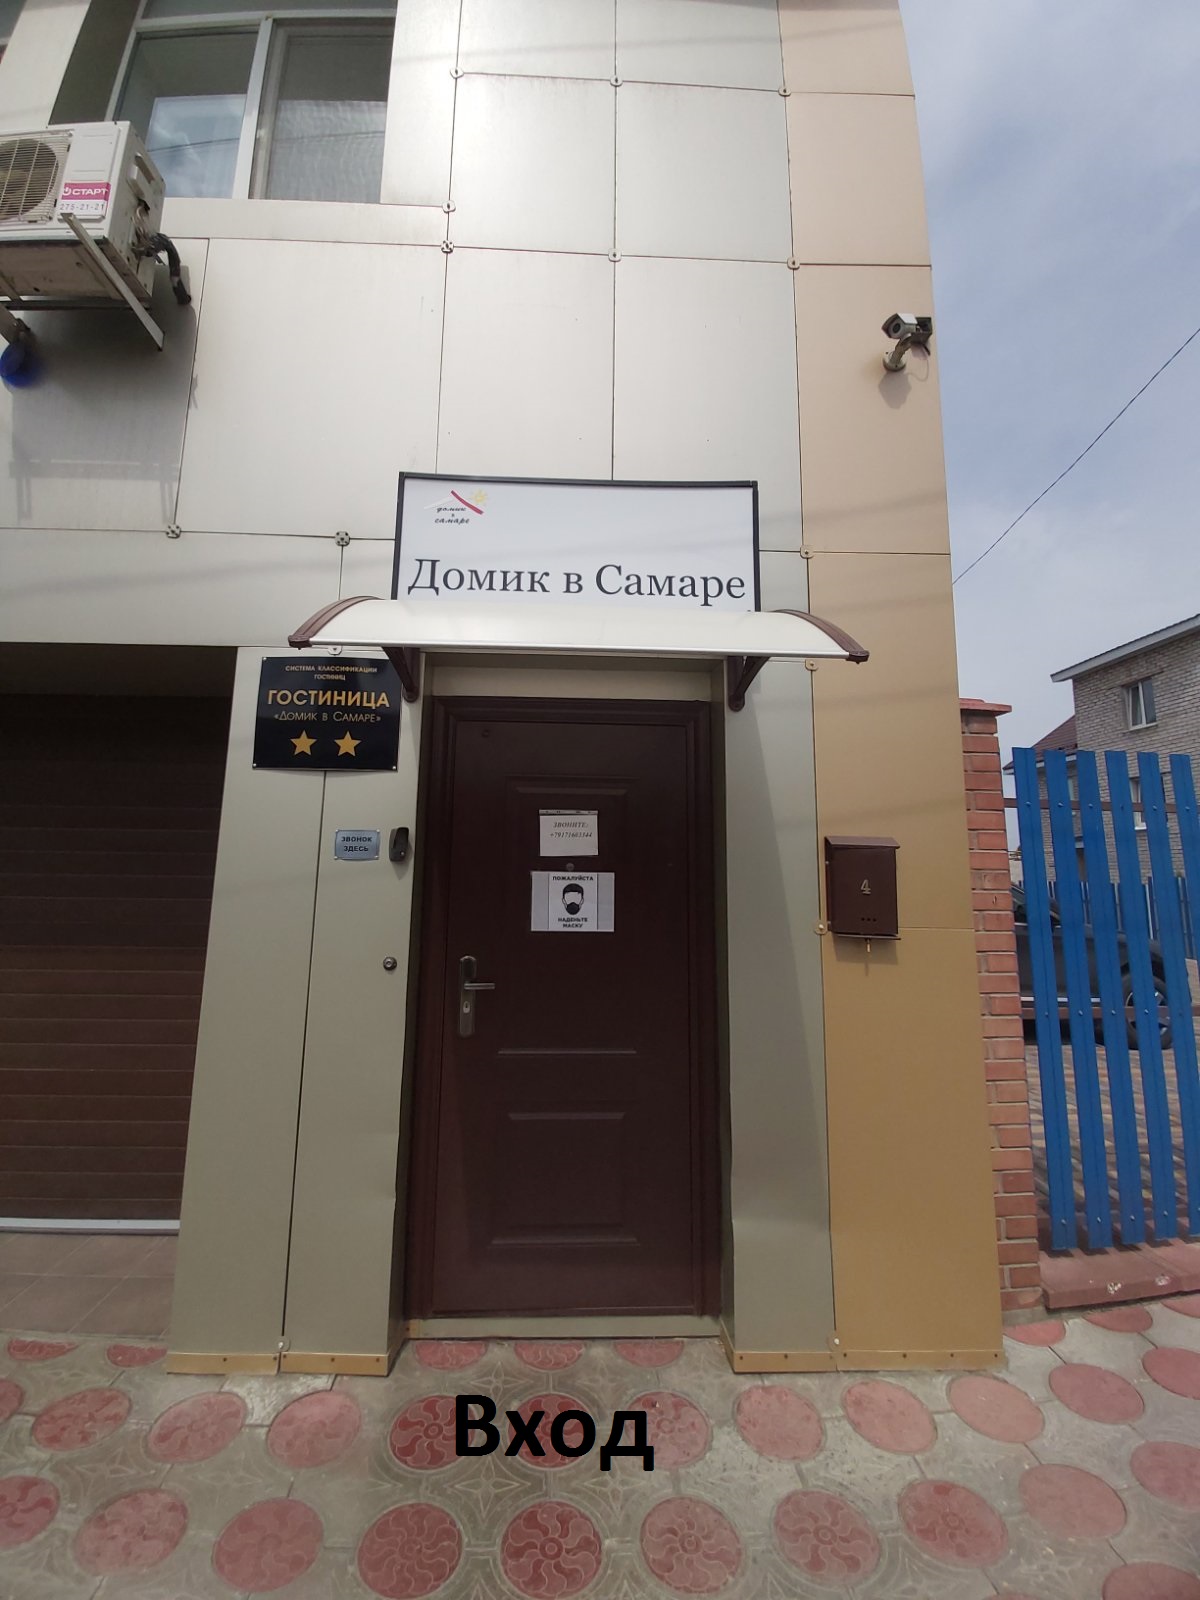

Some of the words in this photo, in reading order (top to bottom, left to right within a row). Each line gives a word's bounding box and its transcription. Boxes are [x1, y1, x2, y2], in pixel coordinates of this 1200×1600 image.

[72, 188, 109, 196] СТАРТ
[60, 203, 105, 211] 275-21-21
[407, 558, 551, 596] Домик
[563, 572, 584, 594] в
[595, 564, 747, 607] Самаре
[318, 665, 378, 673] КЛАССИФИКАЦИИ
[267, 689, 390, 709] ГОСТИНИЦА
[860, 879, 872, 895] 4
